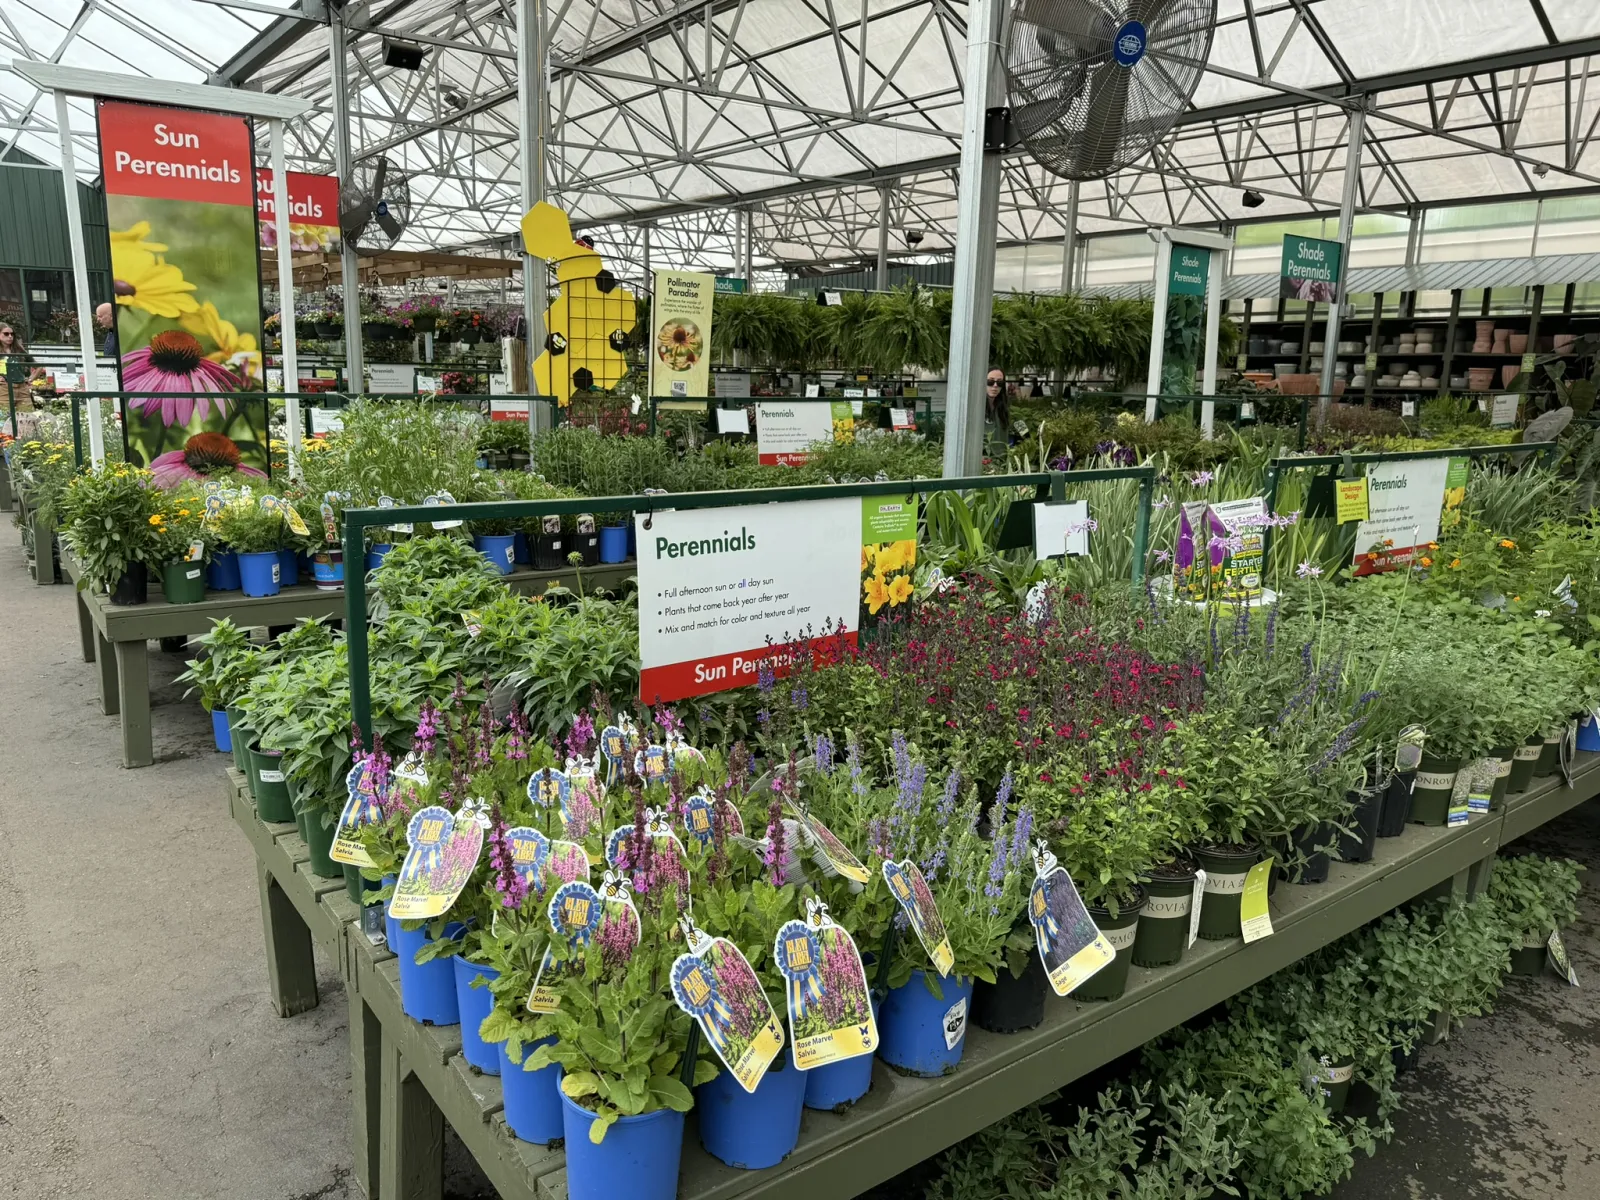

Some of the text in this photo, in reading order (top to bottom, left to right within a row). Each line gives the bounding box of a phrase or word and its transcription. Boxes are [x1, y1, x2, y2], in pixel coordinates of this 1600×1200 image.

[154, 123, 199, 149] Sun
[115, 150, 241, 184] Perennials
[255, 172, 275, 194] Su
[1297, 241, 1324, 261] Shade
[1181, 256, 1199, 267] Shade
[1173, 271, 1202, 284] Perennials
[1287, 260, 1331, 280] Perennials
[667, 277, 701, 289] Pollinator
[714, 278, 733, 290] hade
[668, 287, 699, 298] Paradise
[761, 408, 795, 418] Perennials
[776, 454, 788, 463] Sun
[1370, 474, 1408, 491] Perennials
[656, 526, 756, 560] Perennials
[664, 587, 677, 599] Full
[679, 585, 713, 597] afternoon
[715, 584, 727, 592] sun
[737, 578, 747, 589] all
[748, 577, 761, 588] day
[762, 578, 774, 586] sun
[664, 592, 789, 617] Plants that come back year after year
[664, 605, 811, 634] Mix and match for color and texture all year
[694, 663, 726, 684] Sun
[539, 780, 559, 790] BEW
[417, 828, 441, 842] LABEL
[335, 846, 353, 856] Salvia
[337, 841, 366, 852] Rose Mar
[394, 902, 411, 910] Salvia
[396, 895, 409, 903] Rose
[564, 896, 591, 914] BLEW
[1147, 902, 1186, 912] ROVIA
[567, 912, 589, 926] ABEL
[785, 936, 809, 953] BLEW
[787, 949, 811, 968] LABEL
[1051, 963, 1070, 981] Blue Hill
[1055, 975, 1068, 987] Sage
[533, 995, 554, 1004] Salvia
[688, 981, 711, 1006] LABEL
[796, 1032, 834, 1049] Rose Marvel
[735, 1046, 755, 1075] Rose Marvel
[798, 1049, 817, 1059] Salvia
[741, 1067, 752, 1083] Salvia
